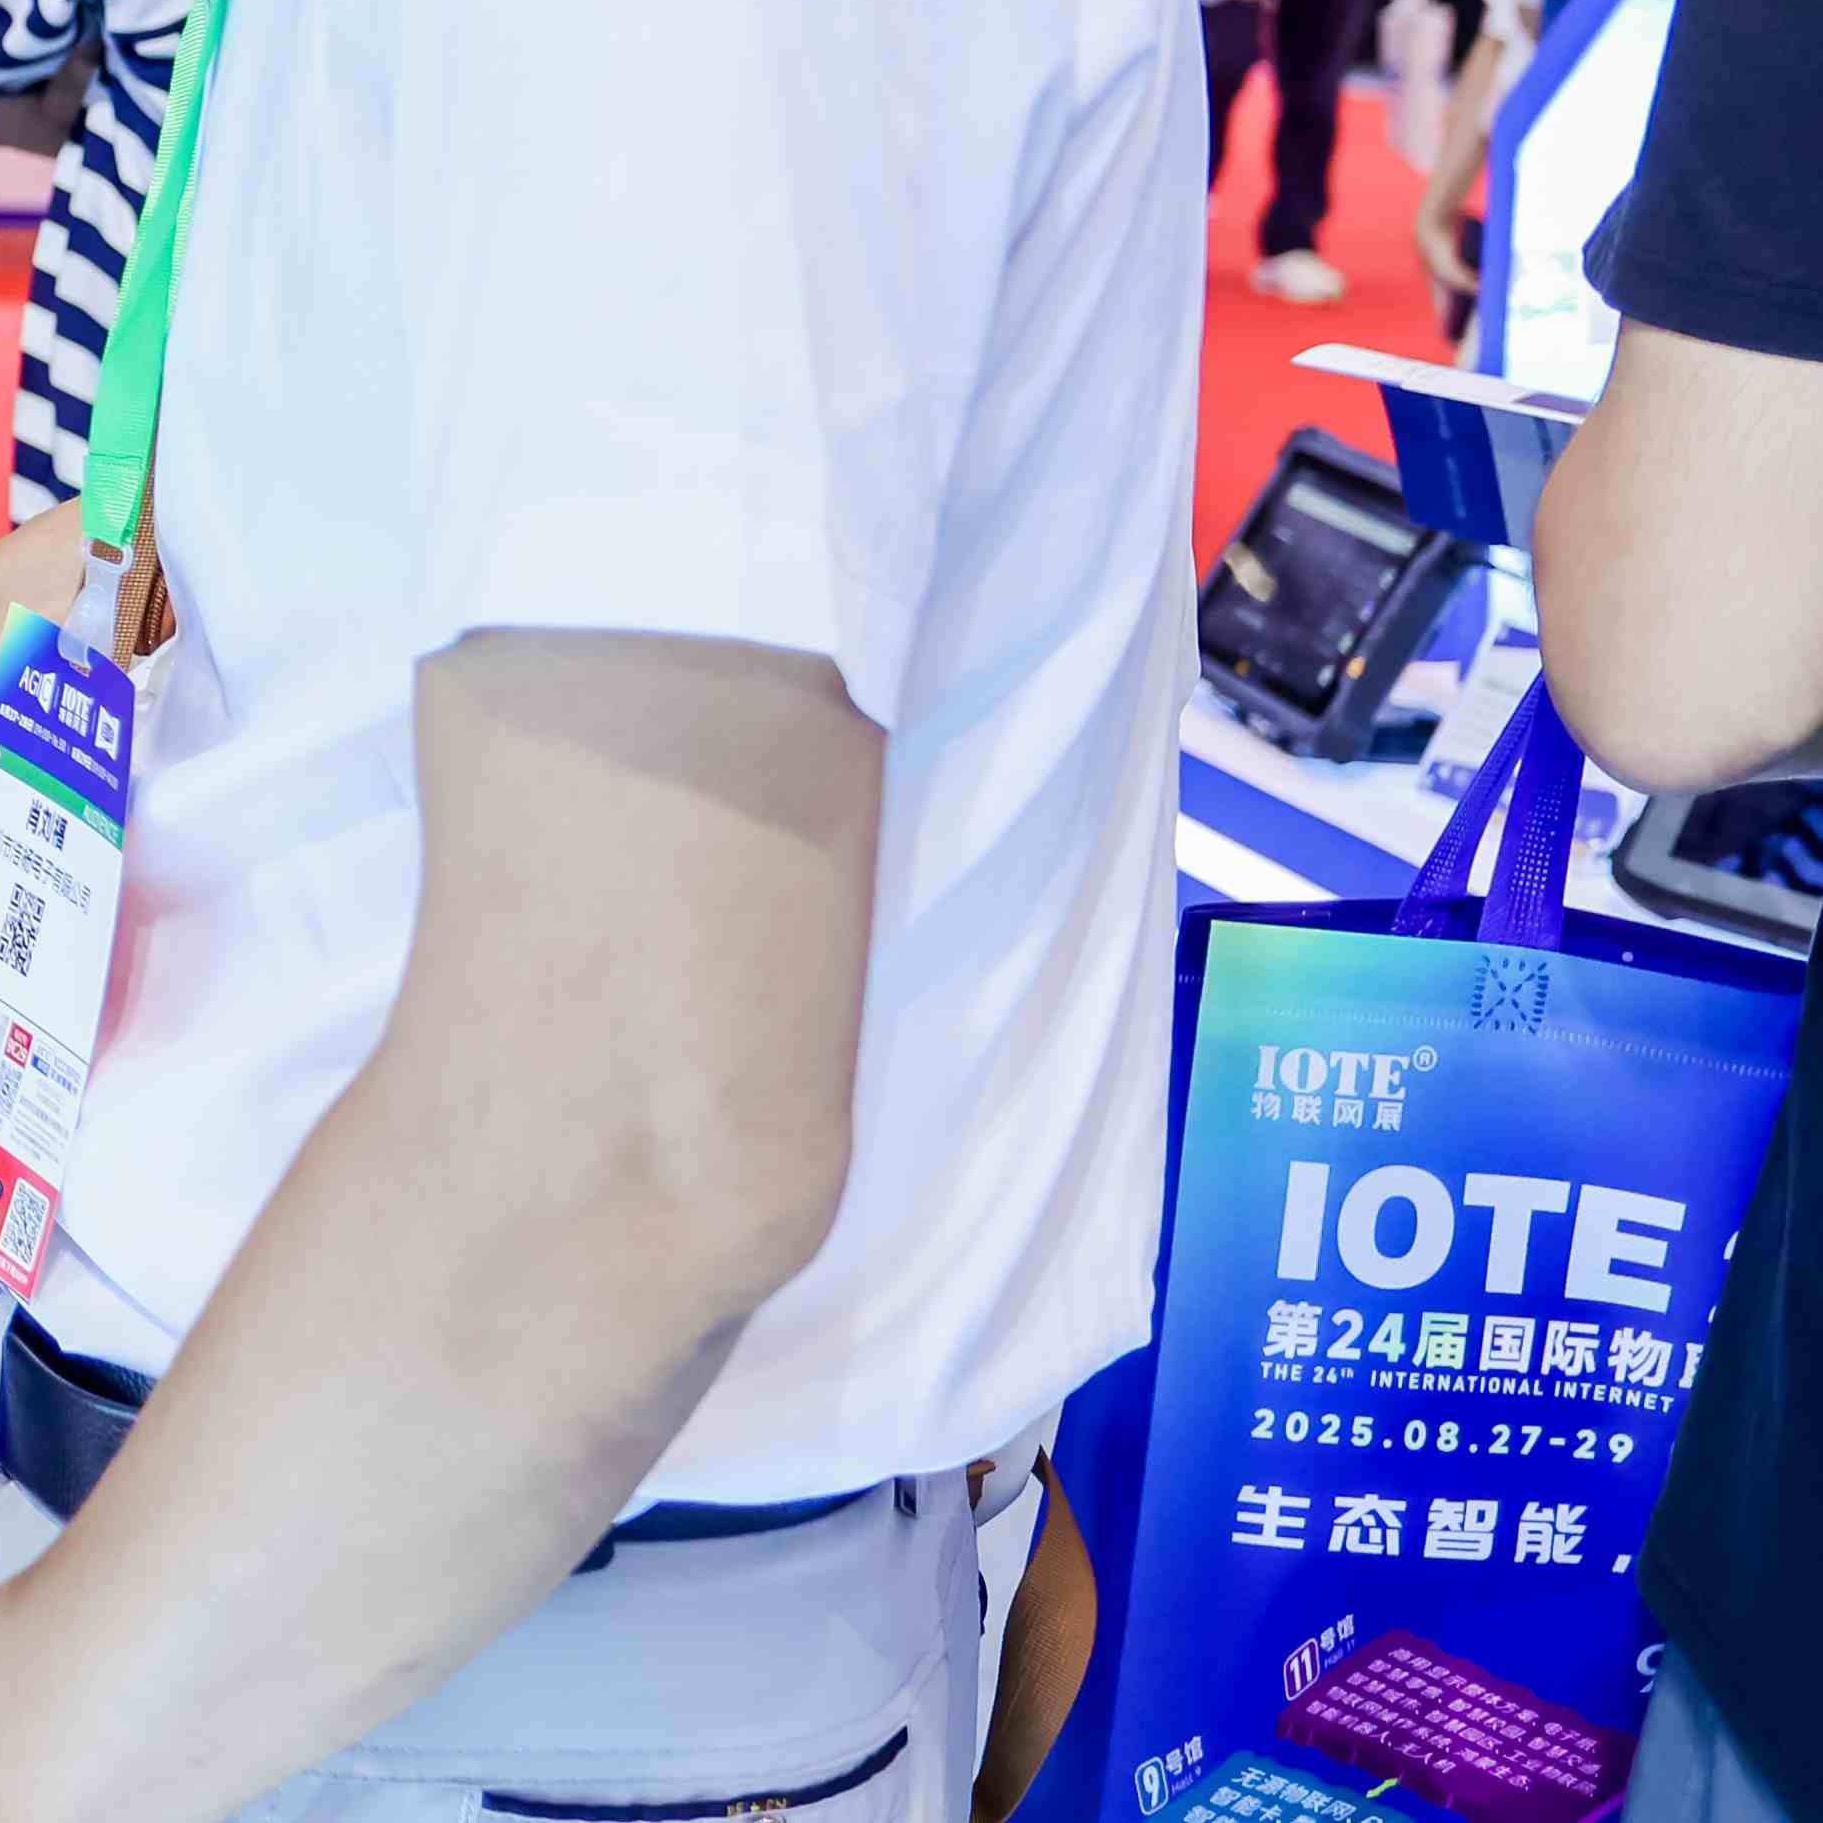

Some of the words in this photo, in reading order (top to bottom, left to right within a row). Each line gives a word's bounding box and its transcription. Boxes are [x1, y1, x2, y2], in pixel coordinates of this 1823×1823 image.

[61, 682, 95, 721] IOTE
[1250, 1091, 1406, 1132] 物联网展
[1276, 1159, 1688, 1315] IOTE
[1261, 1361, 1303, 1384] THE
[1370, 1370, 1545, 1399] INTERNATIONAL
[1554, 1380, 1675, 1415] INTERNET
[1250, 1408, 1636, 1465] 2025.08.27-29
[1289, 1645, 1313, 1693] 11
[1142, 1764, 1160, 1808] 9
